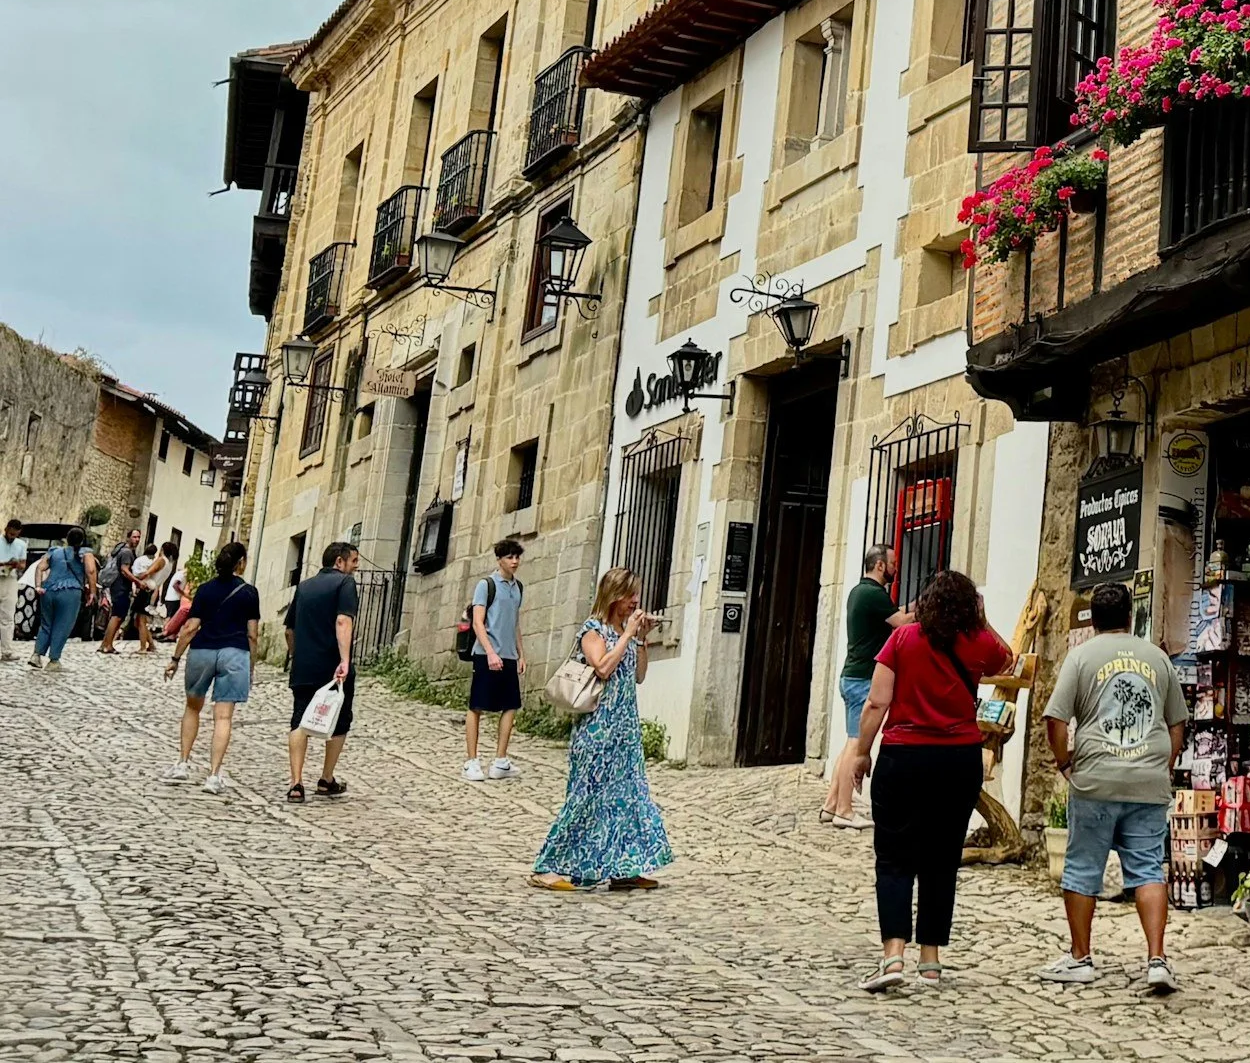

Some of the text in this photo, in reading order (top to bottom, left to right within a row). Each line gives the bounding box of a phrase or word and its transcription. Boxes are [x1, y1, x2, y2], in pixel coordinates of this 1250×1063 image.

[377, 369, 404, 383] Hotel
[367, 381, 409, 395] Altamira
[1080, 493, 1113, 519] Productos
[1086, 517, 1126, 552] SORAYA
[1185, 570, 1203, 591] de
[1096, 658, 1157, 687] SPRINGS
[1101, 741, 1149, 758] CALIFORNIA
